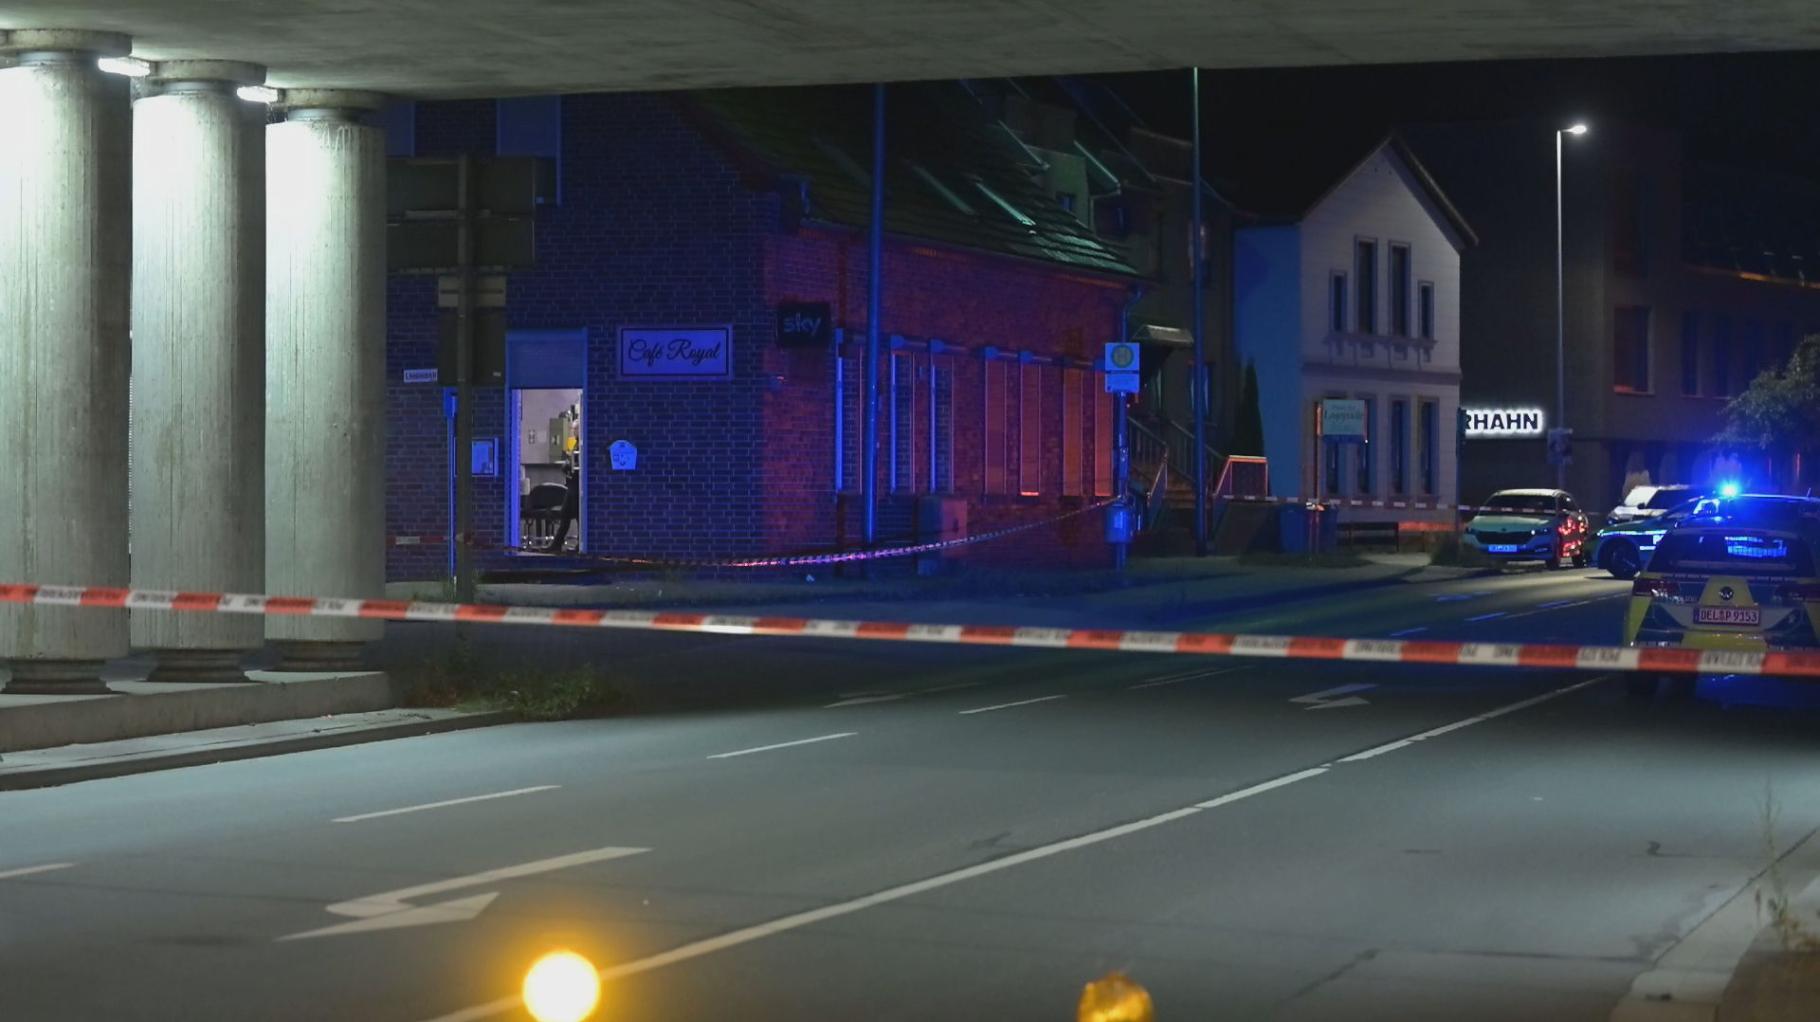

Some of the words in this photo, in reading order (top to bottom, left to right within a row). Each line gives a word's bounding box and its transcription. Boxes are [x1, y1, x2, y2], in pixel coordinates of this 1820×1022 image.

[784, 312, 821, 337] sky
[628, 338, 663, 367] Café
[667, 338, 721, 365] Royal
